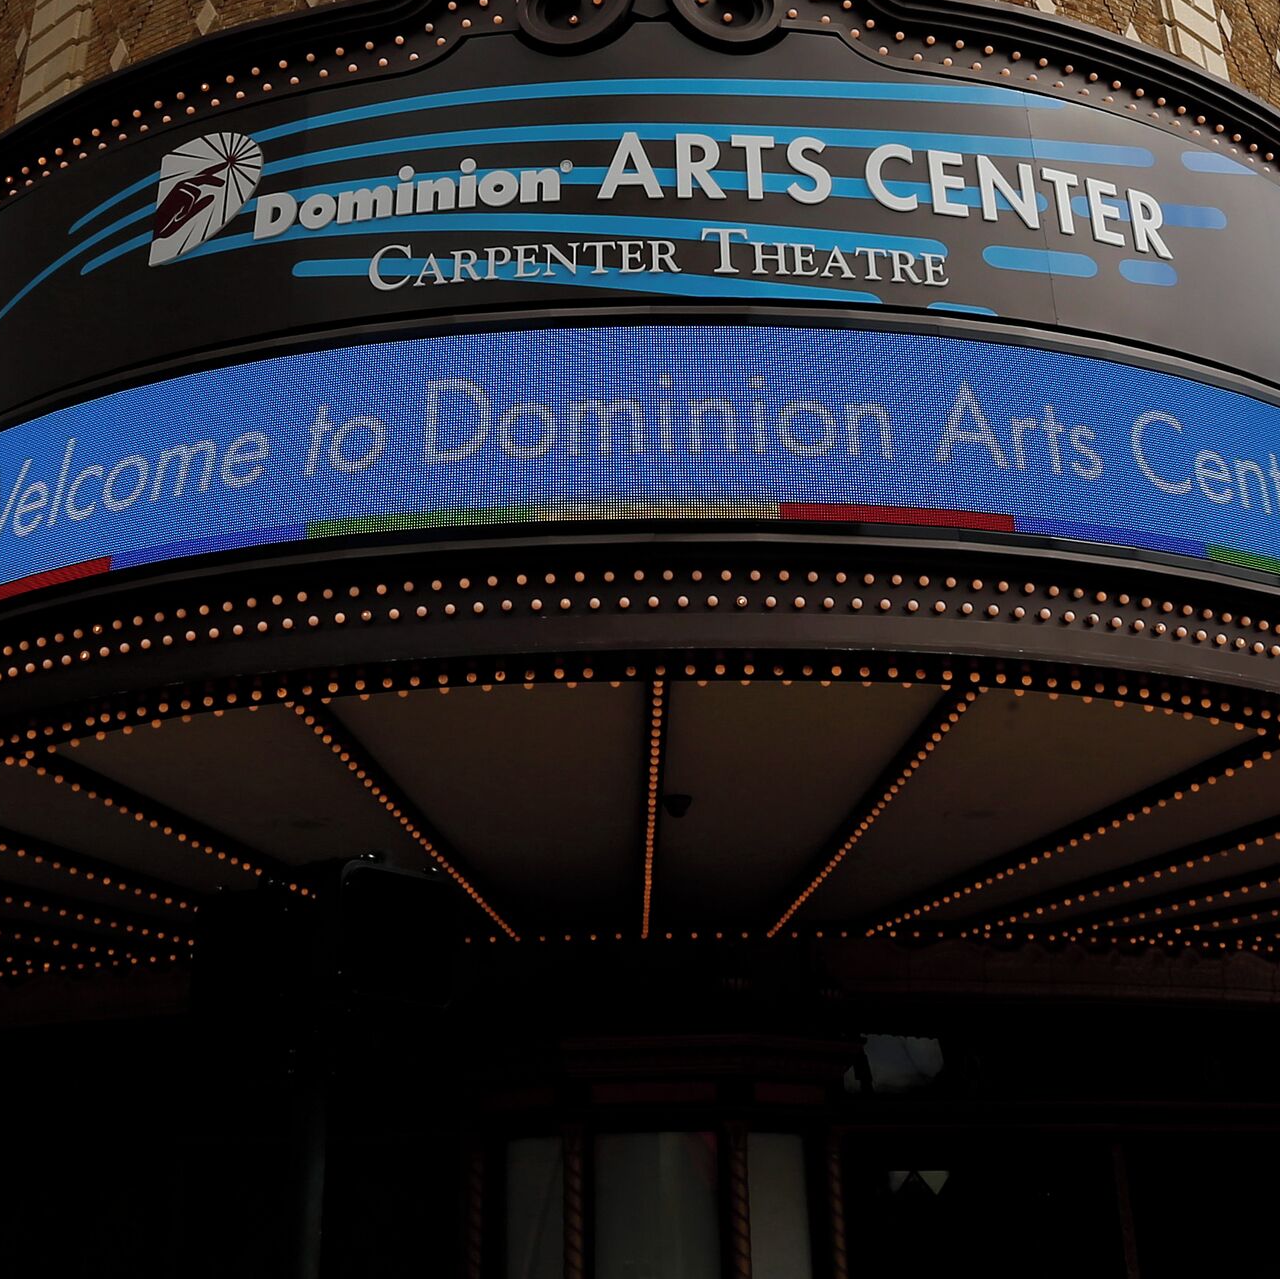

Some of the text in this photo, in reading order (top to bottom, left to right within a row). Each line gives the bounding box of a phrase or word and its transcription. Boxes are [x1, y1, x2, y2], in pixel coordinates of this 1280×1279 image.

[253, 131, 1174, 260] Dominion ARTS CENTER
[369, 228, 949, 291] CARPENTER THEATRE
[303, 404, 388, 478] to
[424, 373, 895, 463] Dominion
[934, 380, 1105, 481] Arts
